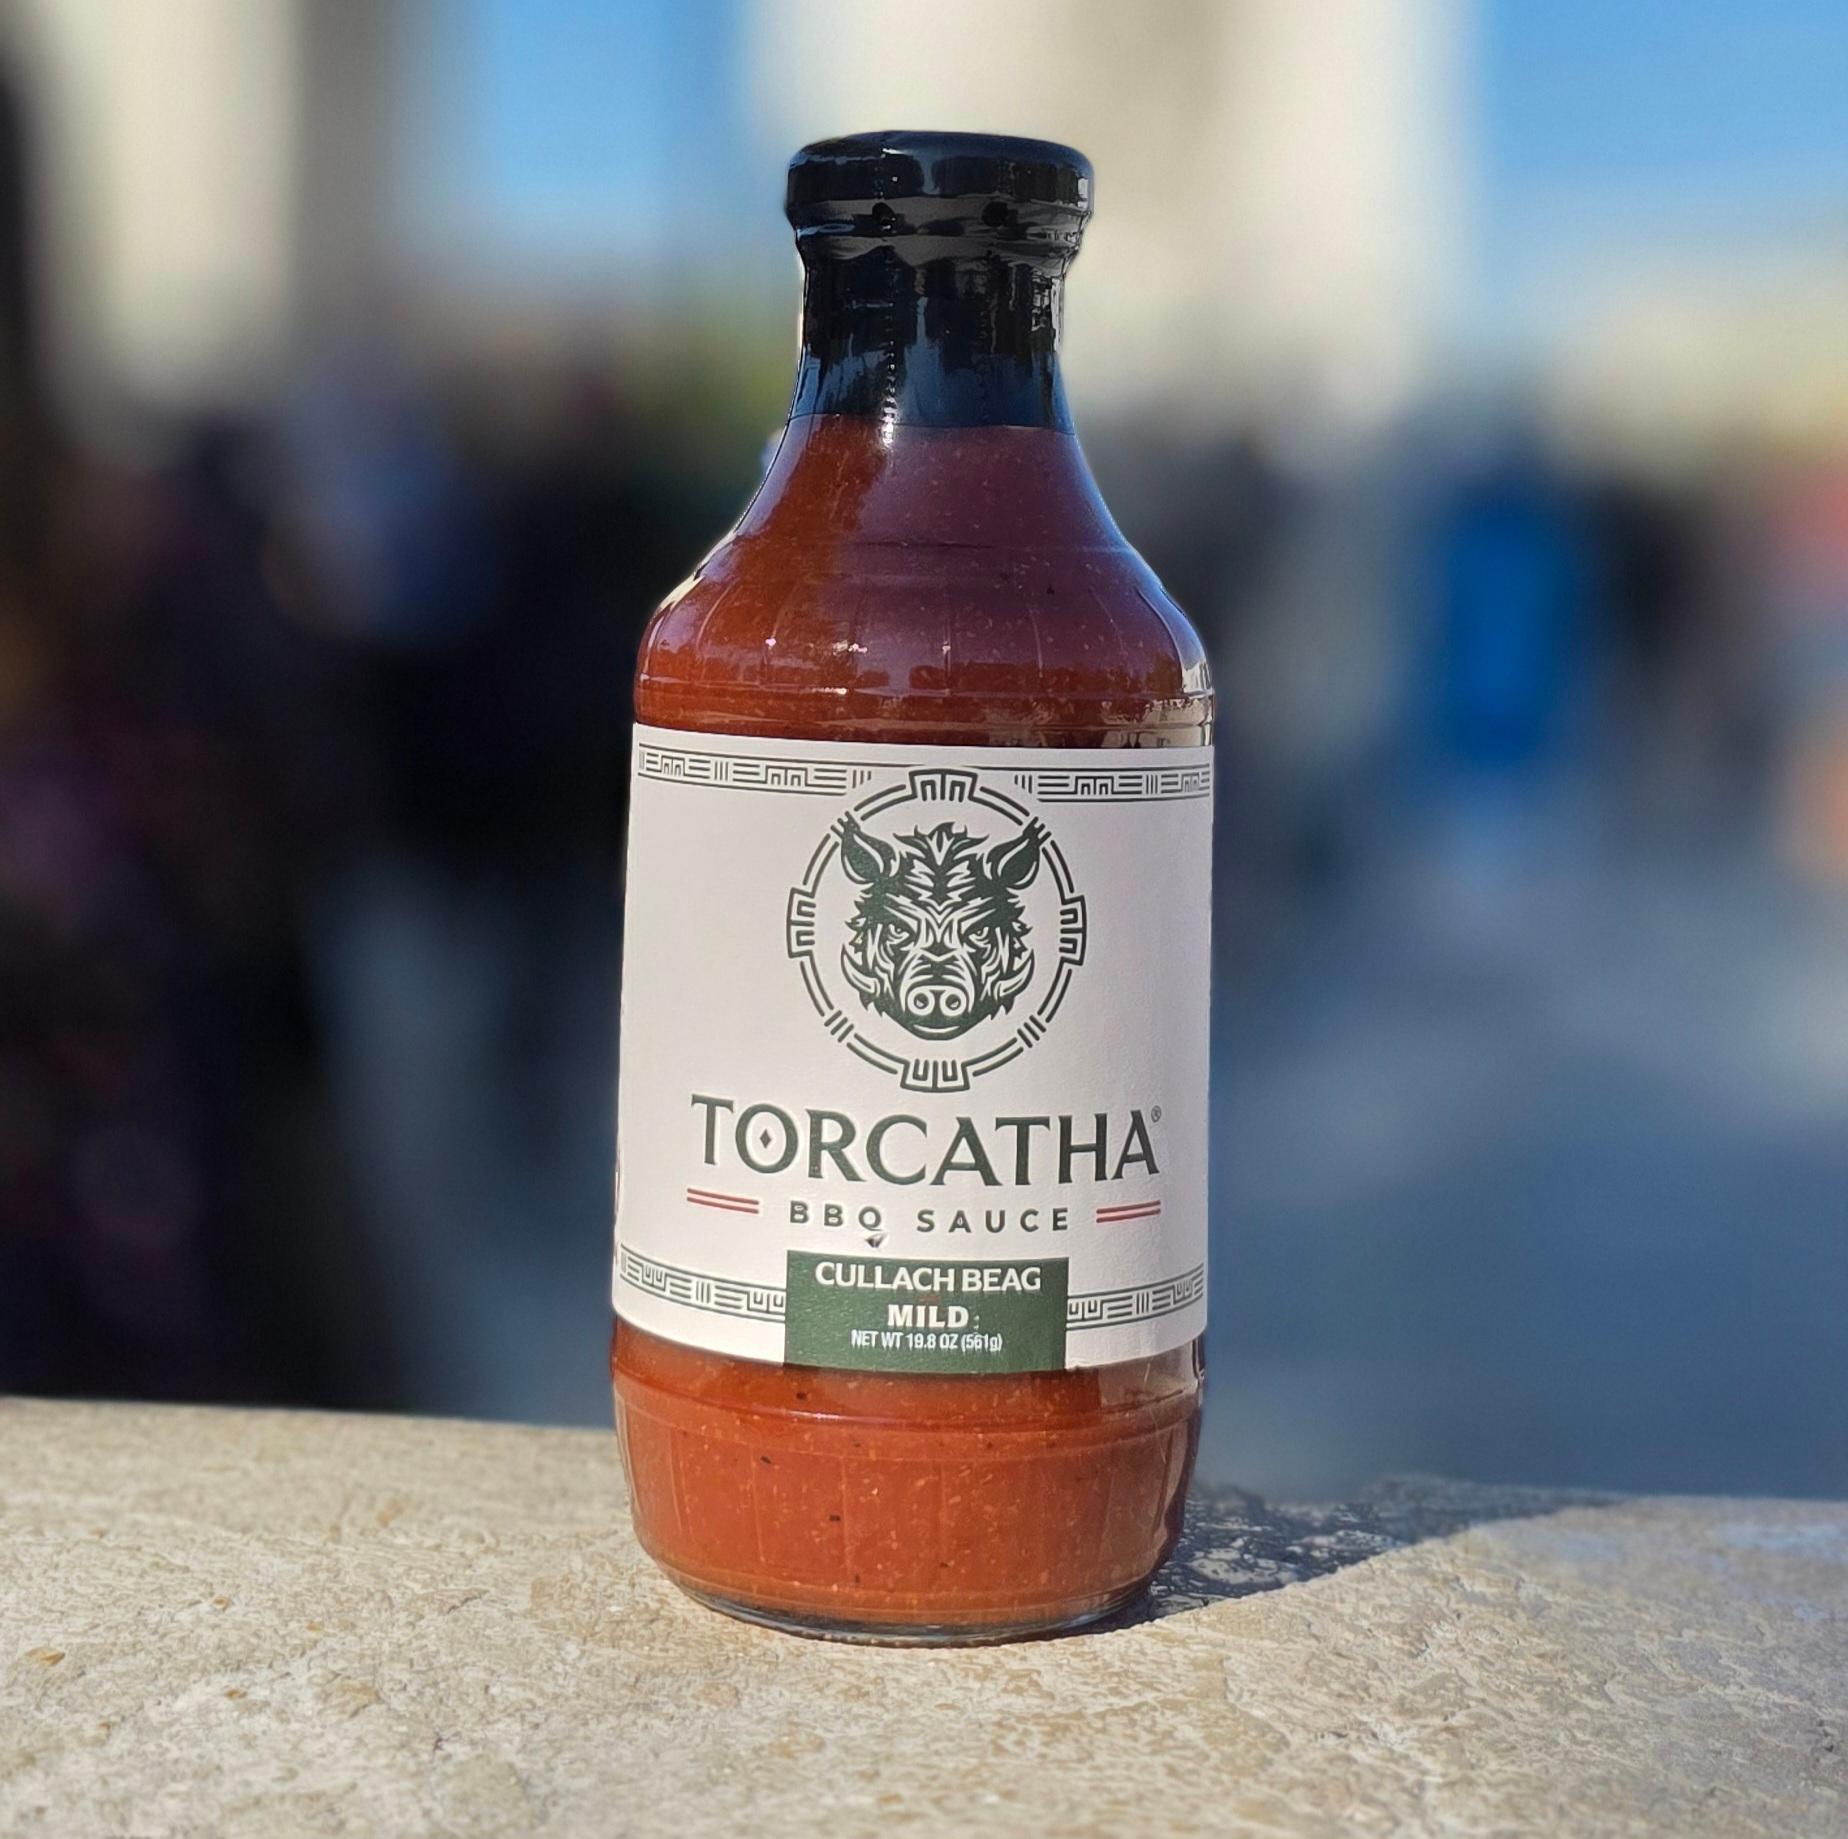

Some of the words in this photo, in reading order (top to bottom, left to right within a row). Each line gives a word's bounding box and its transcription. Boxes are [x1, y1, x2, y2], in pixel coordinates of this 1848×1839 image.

[788, 1200, 884, 1230] BBQ
[915, 1206, 1070, 1234] SAUCE
[814, 1261, 956, 1292] CULLACH
[961, 1265, 1042, 1291] BEAG
[887, 1304, 970, 1329] MILD
[851, 1329, 878, 1348] NET
[880, 1330, 903, 1348] WT
[906, 1332, 937, 1350] 19.8
[940, 1332, 958, 1350] OZ
[961, 1332, 1003, 1353] (561g)
